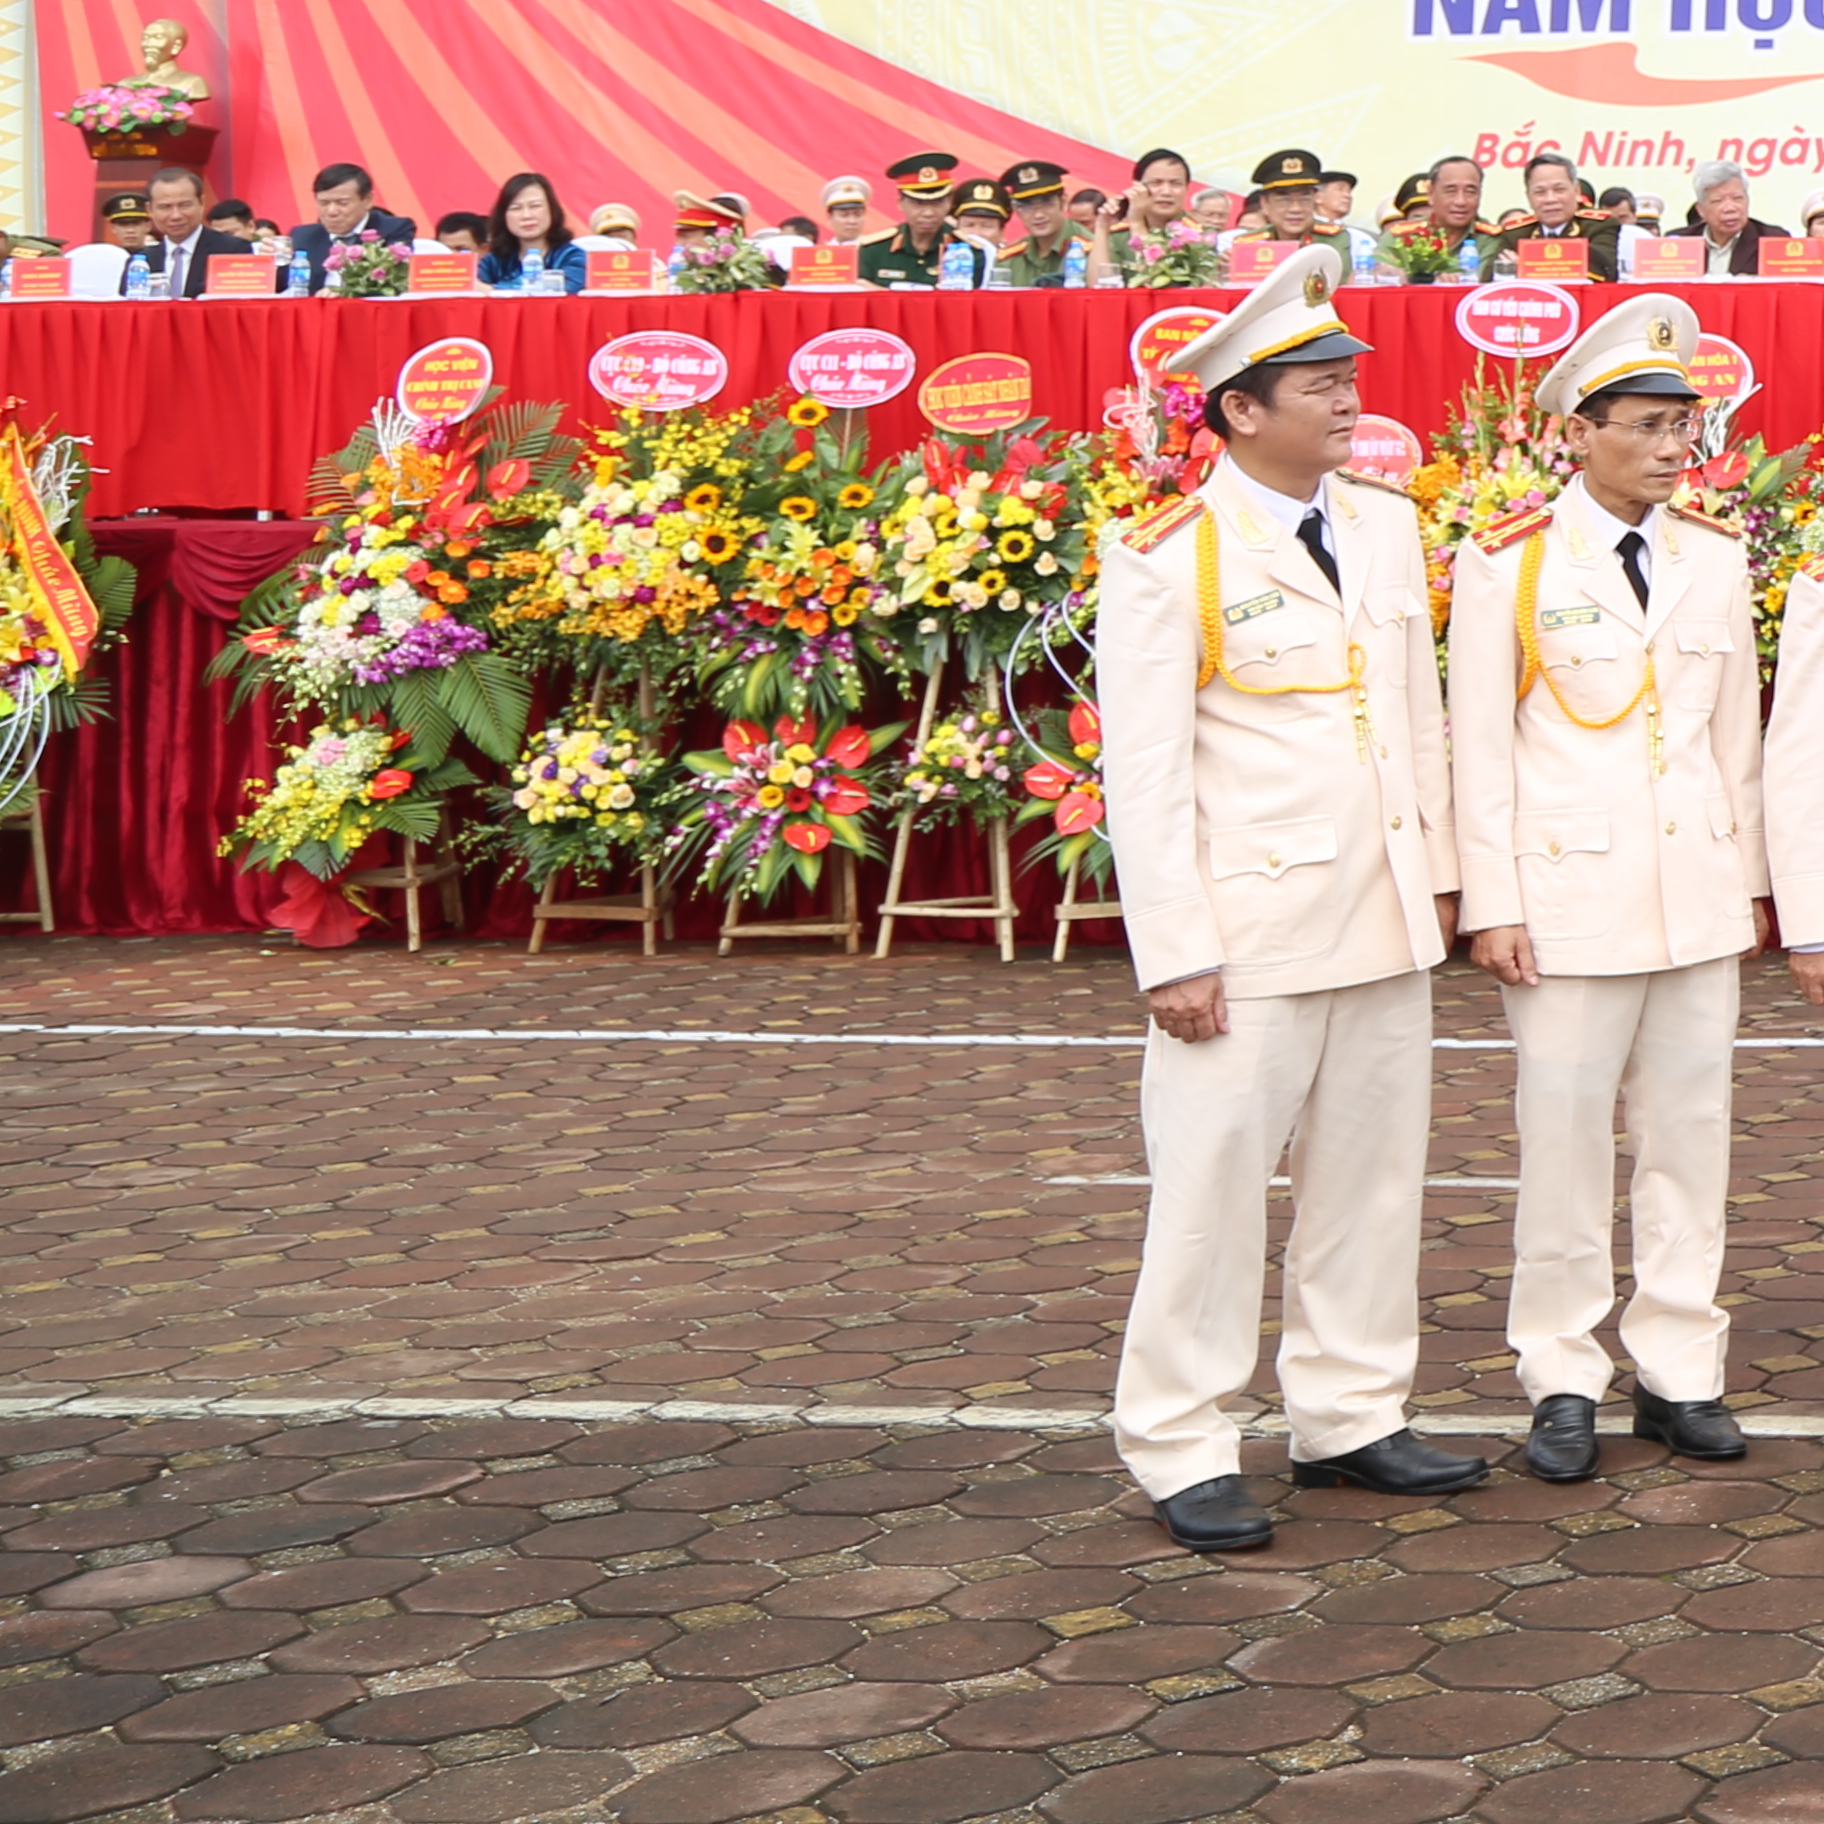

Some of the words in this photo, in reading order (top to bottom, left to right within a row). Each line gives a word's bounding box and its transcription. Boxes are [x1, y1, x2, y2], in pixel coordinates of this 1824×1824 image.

[1472, 120, 1561, 169] Bắc
[1577, 130, 1696, 174] Ninh,
[1155, 328, 1181, 341] BAN
[424, 360, 451, 374] HỌC
[1712, 373, 1736, 385] AN
